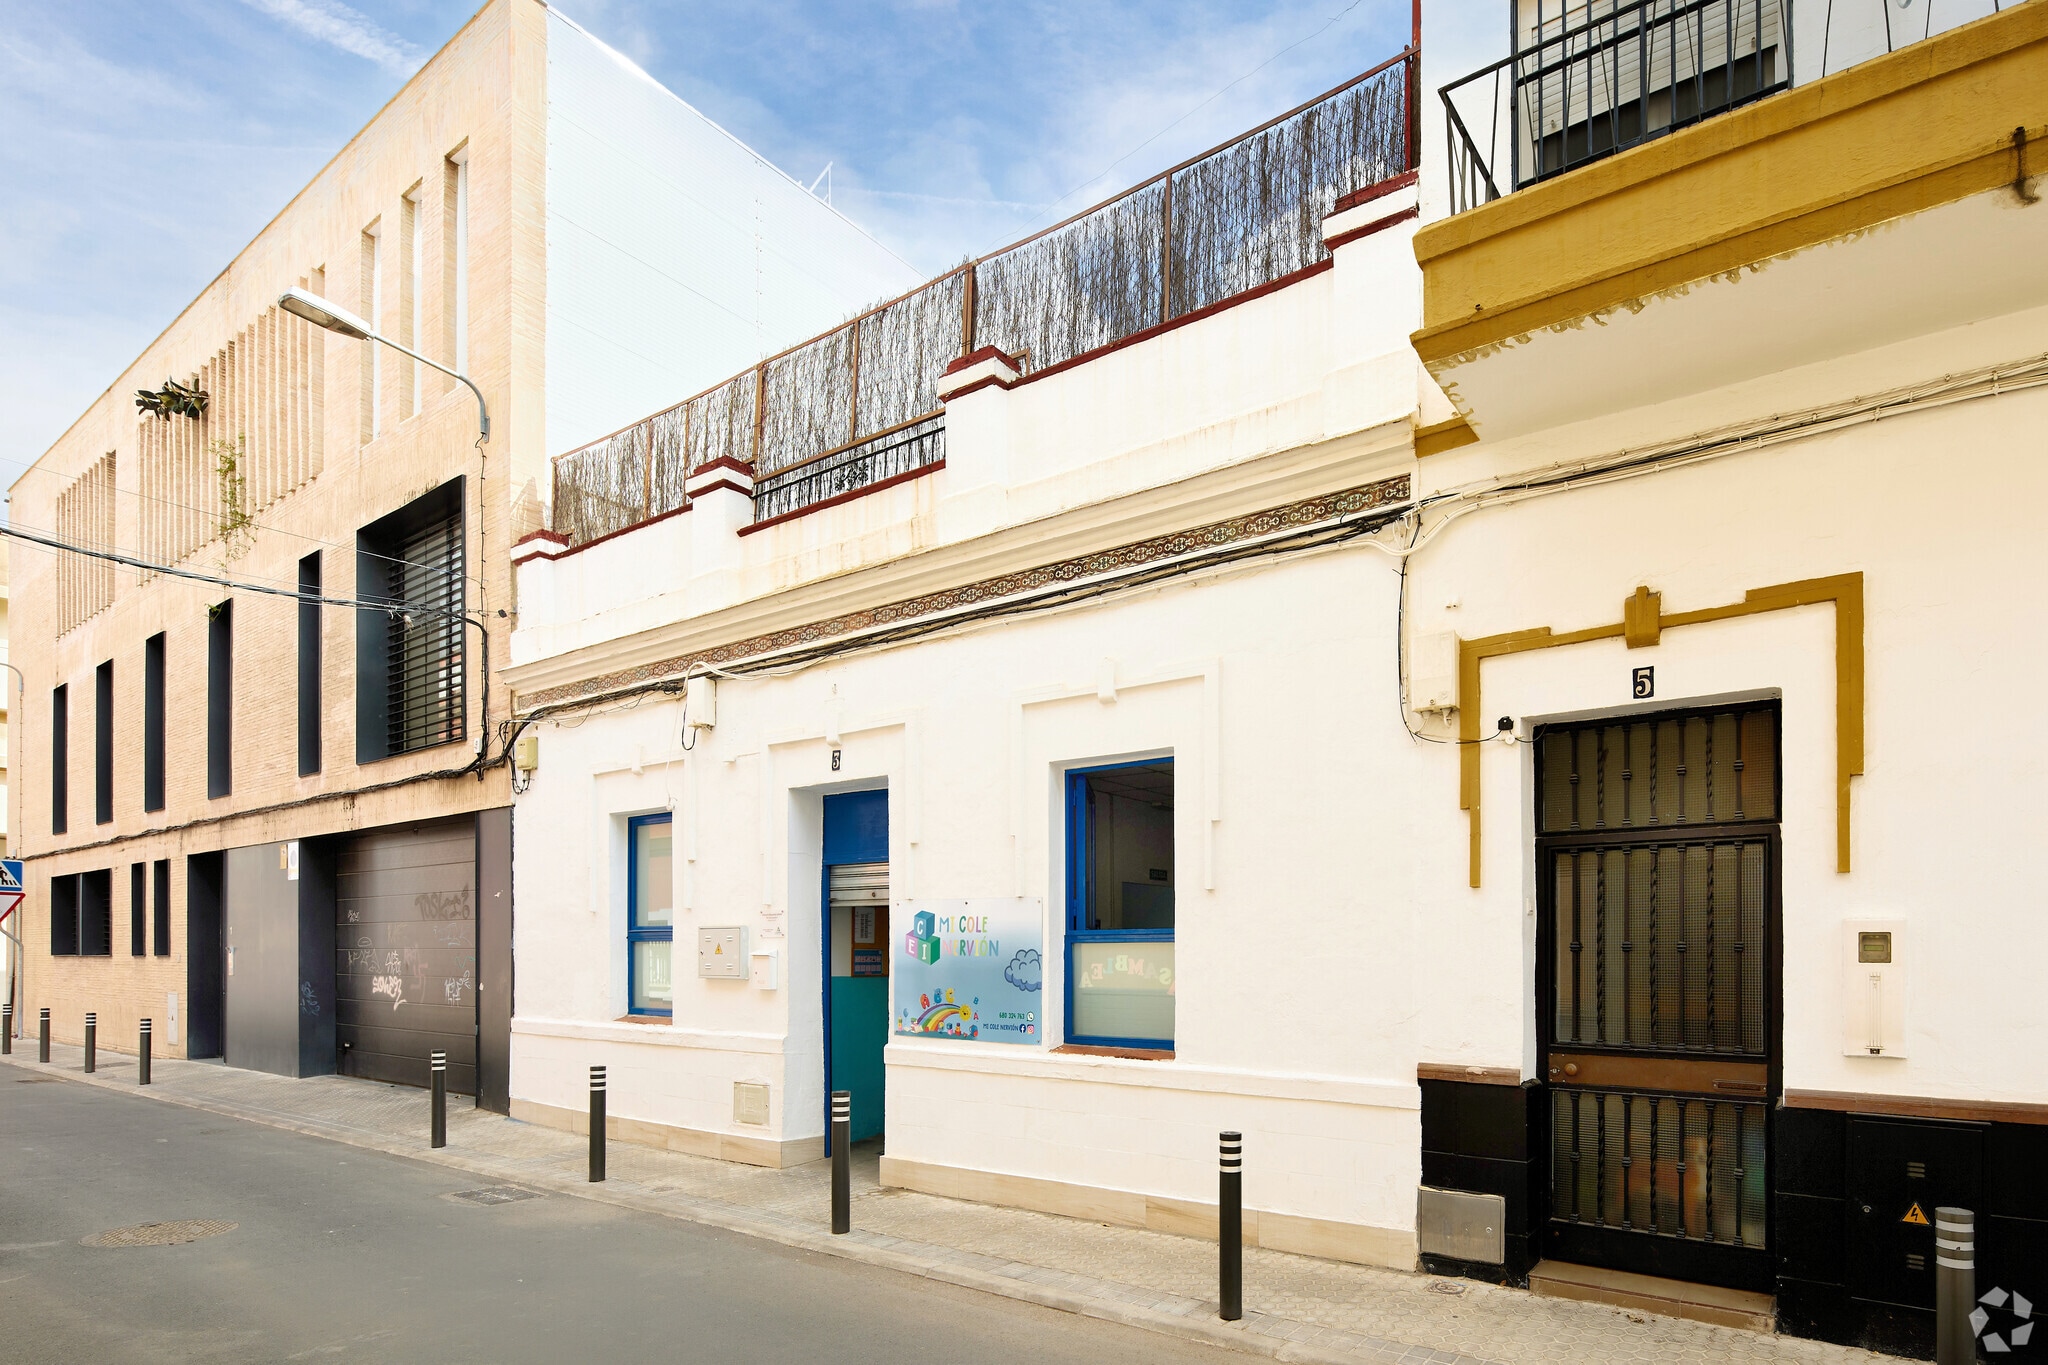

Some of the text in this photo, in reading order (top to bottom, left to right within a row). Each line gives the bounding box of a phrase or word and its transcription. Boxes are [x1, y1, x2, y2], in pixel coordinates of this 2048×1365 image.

[1635, 669, 1651, 697] 5
[833, 752, 840, 769] 3
[939, 915, 988, 933] MI COLE
[942, 935, 999, 957] NERVIÓN
[989, 1023, 1000, 1031] COLE
